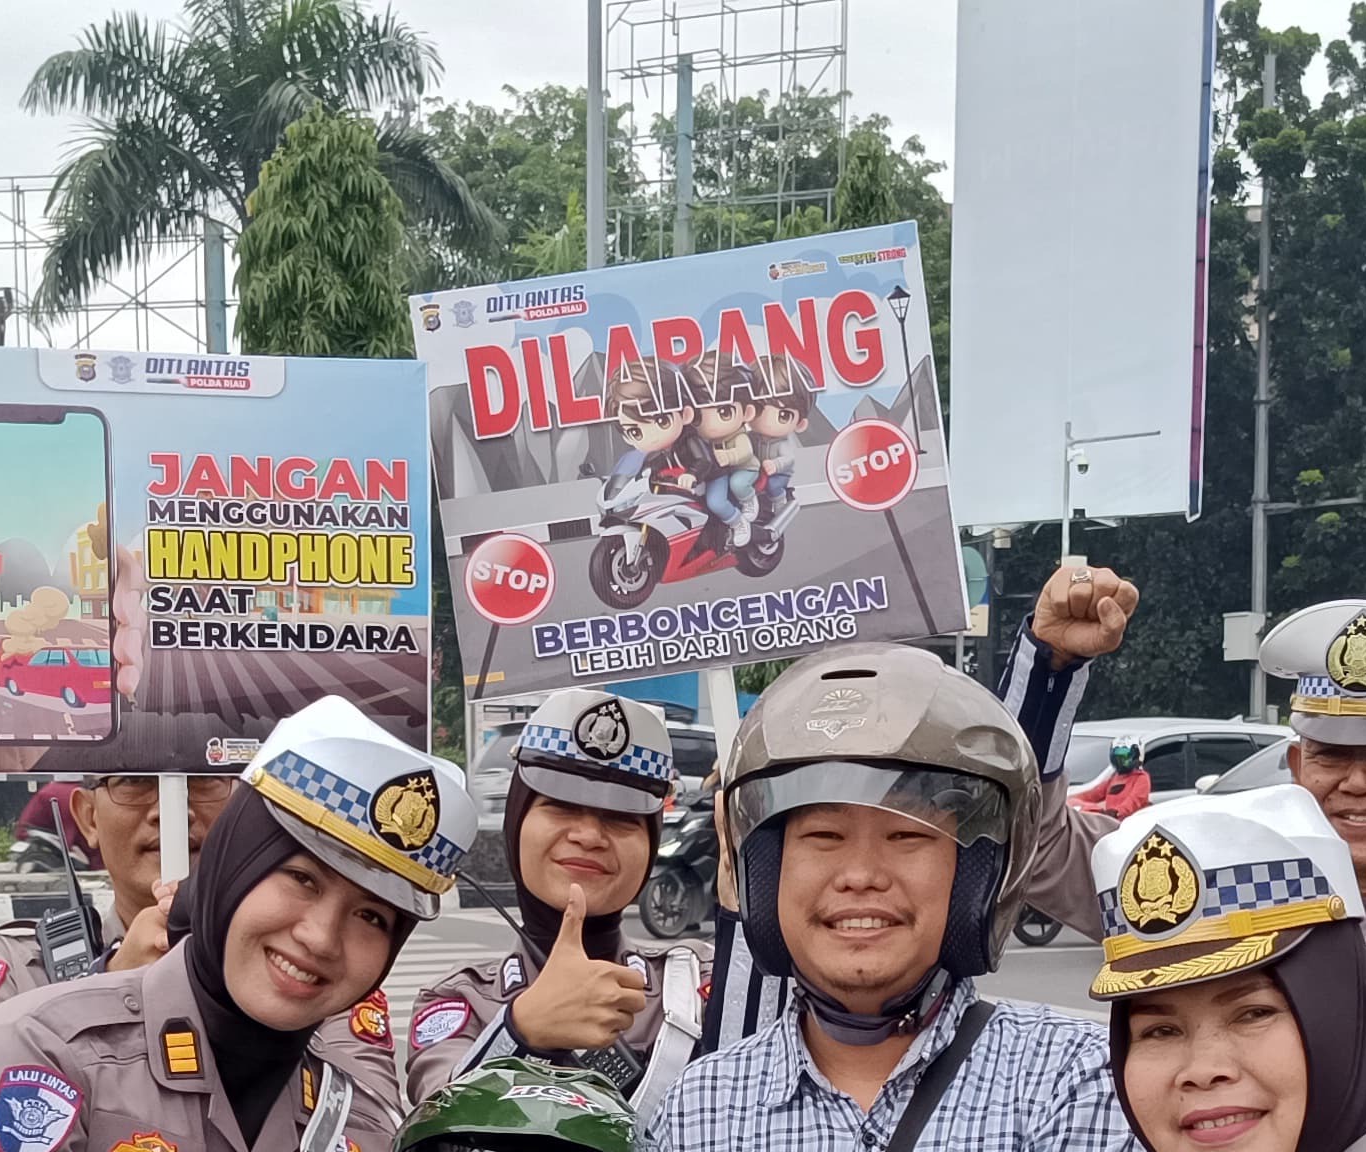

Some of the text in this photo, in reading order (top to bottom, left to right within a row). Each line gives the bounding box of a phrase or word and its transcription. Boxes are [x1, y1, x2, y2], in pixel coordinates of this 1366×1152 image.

[486, 285, 585, 313] DITLANTAS
[529, 304, 584, 319] POLDA RIAU
[145, 357, 251, 377] DITLANTAS
[464, 289, 886, 440] DILARANG
[190, 378, 247, 389] POLDA RIAU
[147, 453, 408, 502] JANGAN
[835, 443, 906, 485] STOP
[147, 500, 410, 528] MENGGUNAKAN
[147, 531, 415, 585] HANDPHONE
[473, 560, 547, 594] STOP
[149, 587, 255, 615] SAAT
[534, 576, 888, 657] BERBONCENGAN
[150, 621, 419, 653] BERKENDARA
[571, 615, 858, 677] LEBIH DARI 1 ORANG
[9, 1070, 77, 1100] LALU LINTAS
